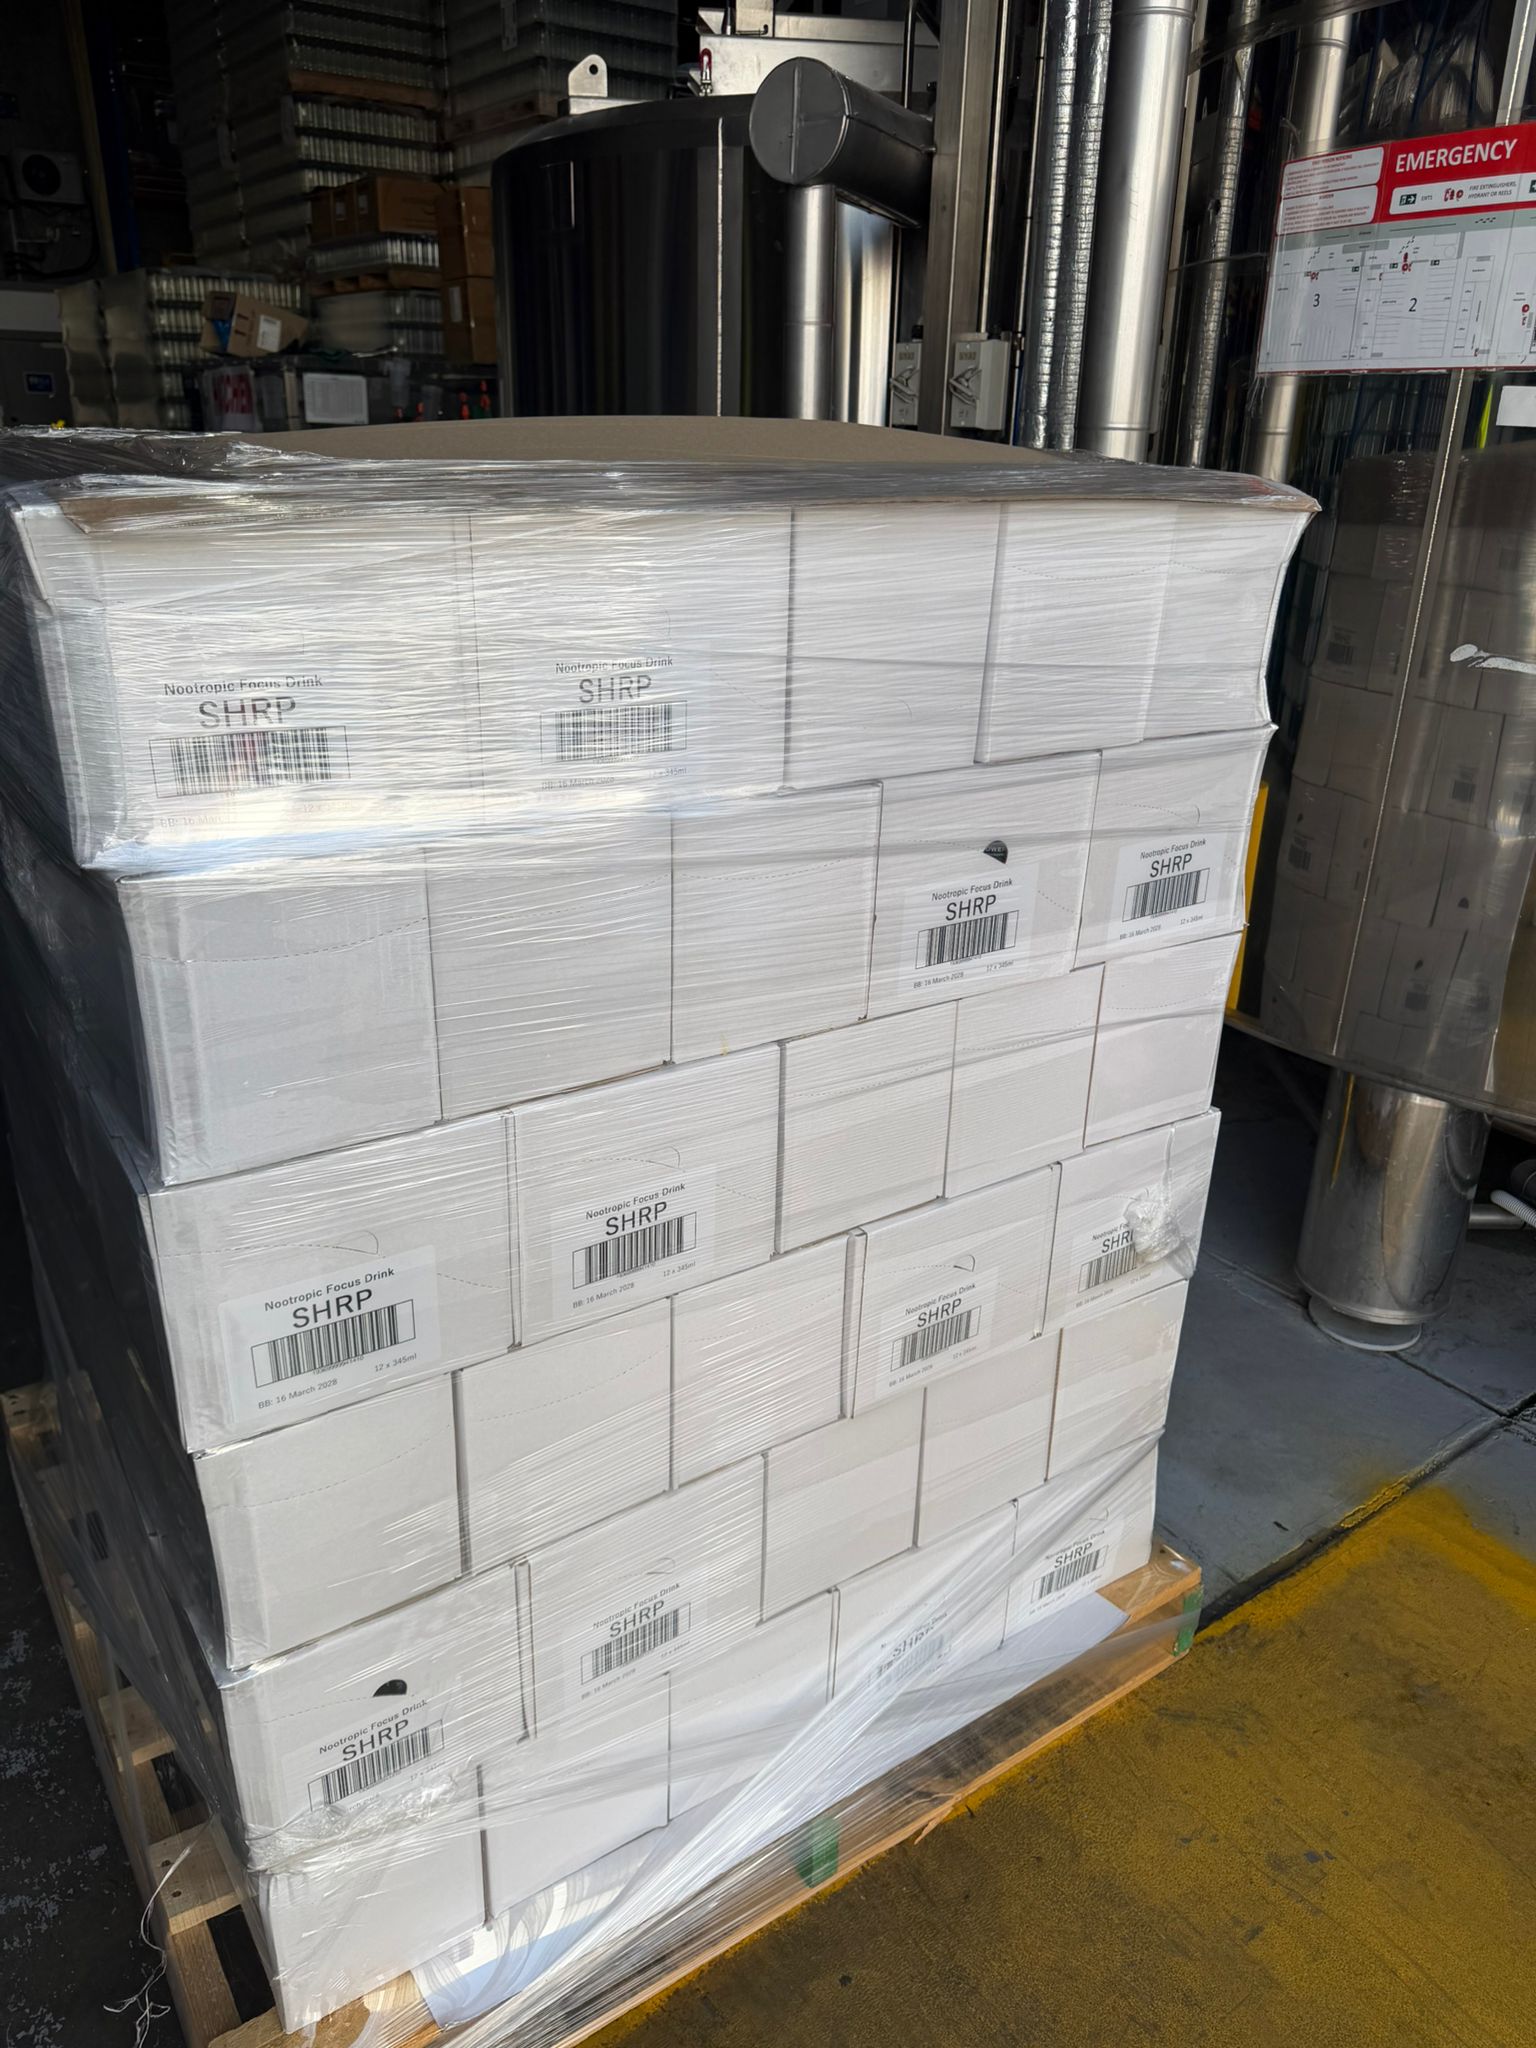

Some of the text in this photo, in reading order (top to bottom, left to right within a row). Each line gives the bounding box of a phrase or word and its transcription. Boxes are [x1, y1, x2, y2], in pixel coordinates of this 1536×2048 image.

[1395, 138, 1518, 173] EMERGENCY
[1468, 190, 1491, 199] HYDRANT
[1499, 189, 1512, 197] REELS
[1313, 293, 1321, 307] 3
[1408, 297, 1418, 312] 2
[646, 656, 673, 667] Drink
[164, 675, 323, 695] Nootropic Focus Drink
[579, 675, 651, 704] SHRP
[199, 696, 296, 729] SHRP
[1140, 838, 1206, 860] Nootropic Focus Drink
[1150, 853, 1192, 878] SHRP
[932, 878, 1013, 901] Nootropic Focus Drink
[945, 894, 997, 921] SHRP
[913, 981, 922, 989] BB:
[932, 975, 950, 985] March
[951, 972, 964, 982] 2028
[986, 964, 993, 973] 12
[586, 1183, 686, 1220] Nootropic Focus Drink
[605, 1201, 667, 1236] SHRP
[677, 1261, 696, 1272] 345ml
[264, 1267, 395, 1311] Nootropic Focus Drink
[586, 1295, 595, 1304] 16
[596, 1289, 618, 1300] March
[619, 1282, 634, 1293] 2028
[292, 1288, 373, 1329] SHRP
[917, 1298, 961, 1328] SHRP
[375, 1362, 384, 1372] 12
[392, 1353, 417, 1367] 345ml
[258, 1379, 338, 1410] BB: 16 March 2028
[1054, 1542, 1093, 1569] SHRP
[609, 1600, 665, 1638] SHRP
[319, 1699, 428, 1754] Nootropic Focus Drink
[342, 1719, 409, 1762] SHRP
